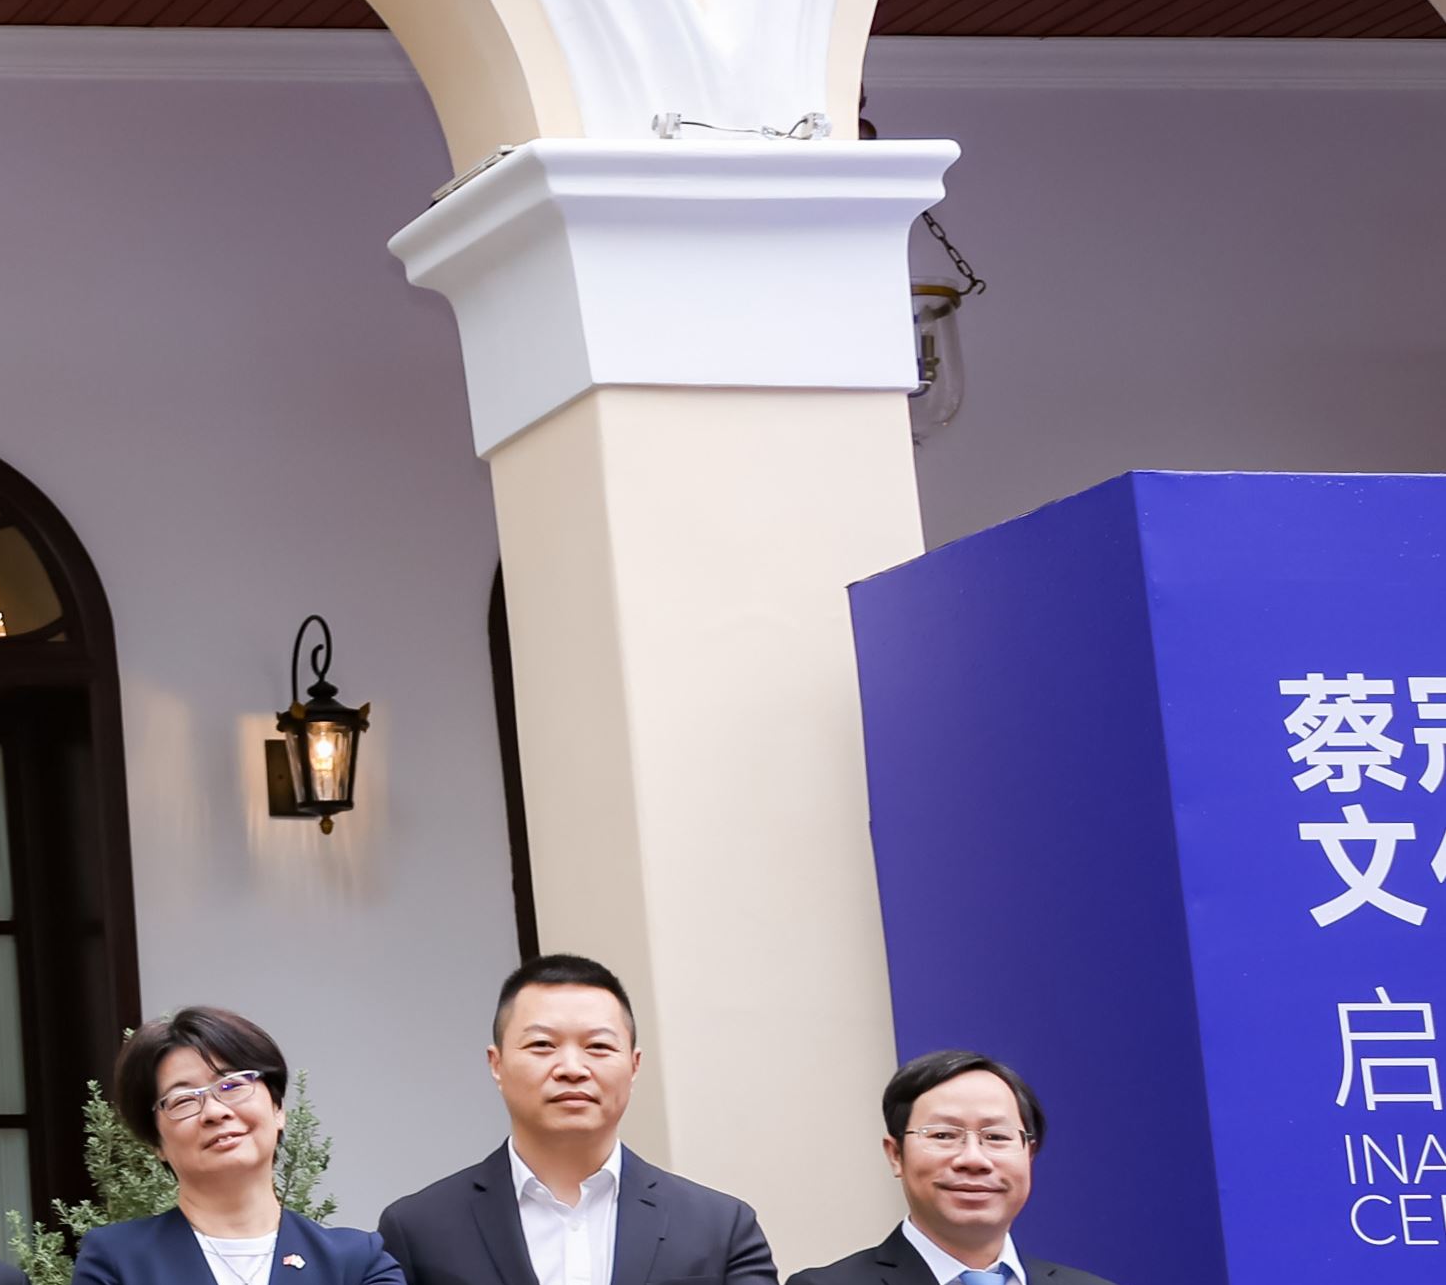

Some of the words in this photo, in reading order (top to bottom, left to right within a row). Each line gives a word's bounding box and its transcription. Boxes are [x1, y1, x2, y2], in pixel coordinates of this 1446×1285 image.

[1299, 804, 1446, 927] 文
[1335, 986, 1444, 1111] 启
[1350, 1194, 1446, 1246] CE
